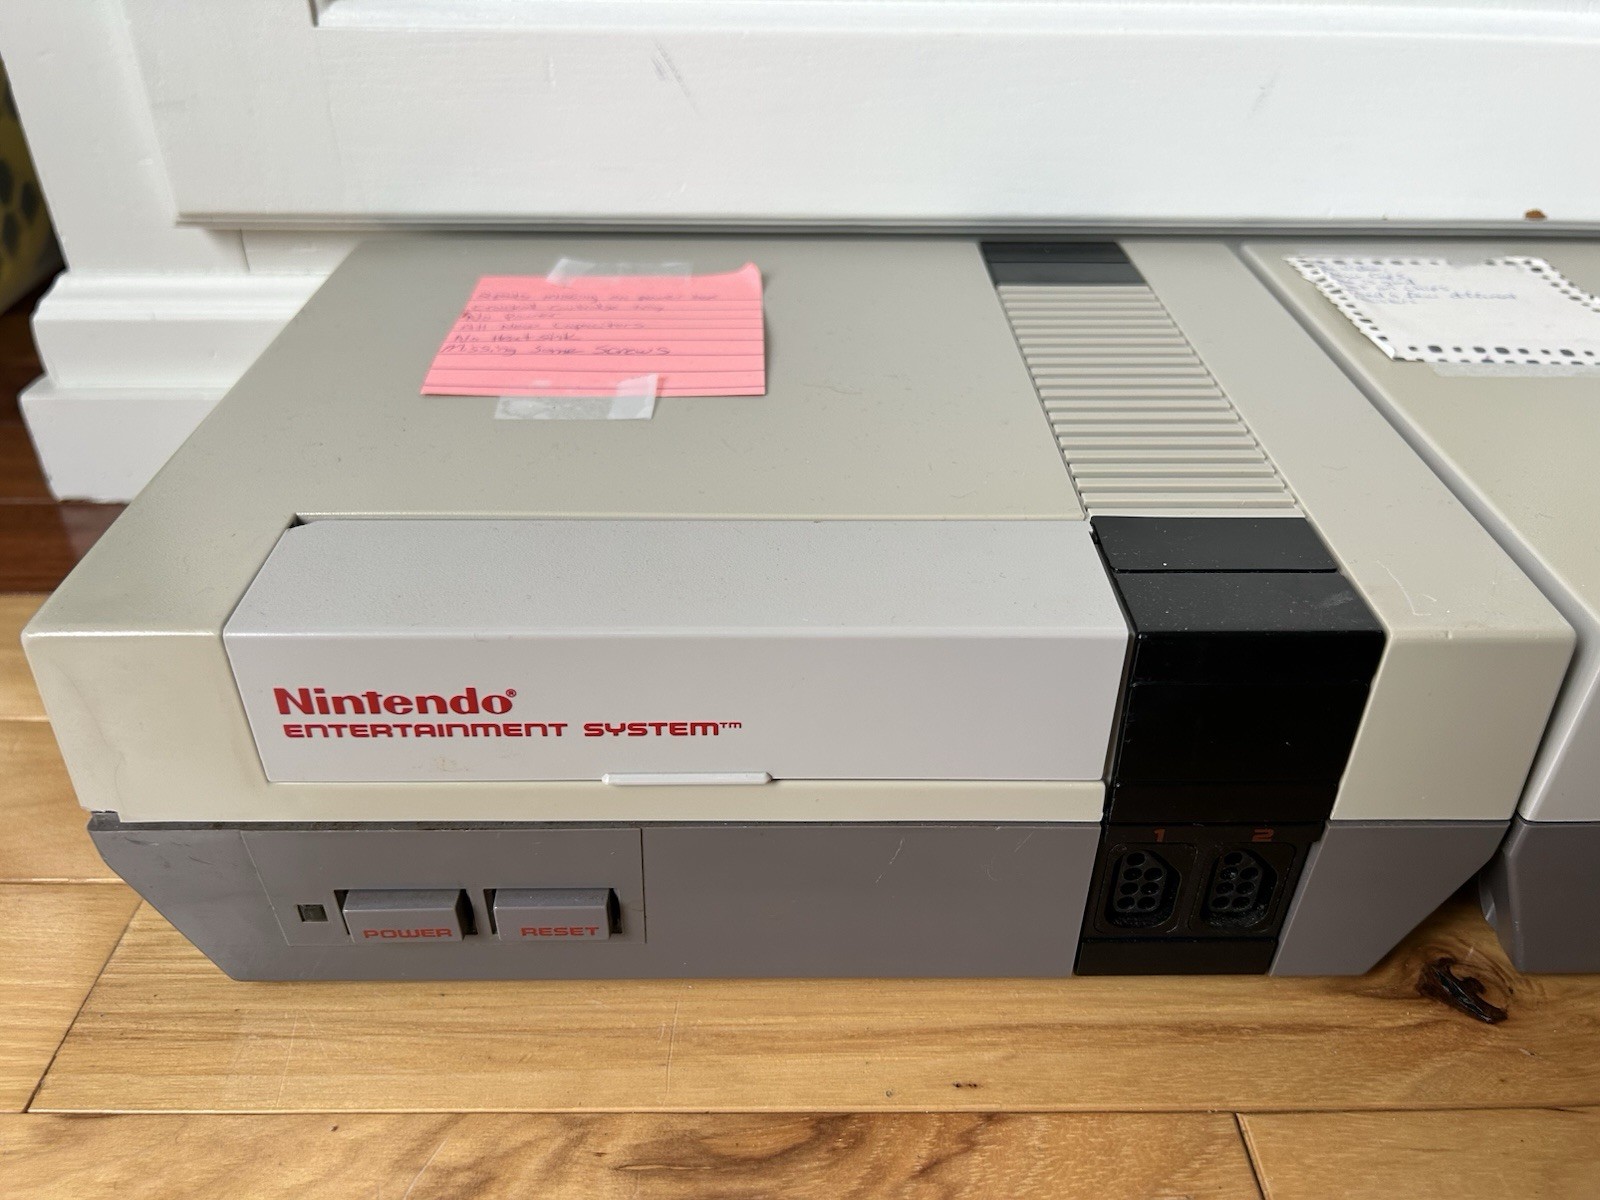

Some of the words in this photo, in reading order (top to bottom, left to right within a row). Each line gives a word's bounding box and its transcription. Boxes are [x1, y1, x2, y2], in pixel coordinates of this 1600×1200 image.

[284, 722, 568, 739] ENTERTAINMENT
[1153, 828, 1166, 843] 1
[1252, 828, 1274, 842] 2
[363, 928, 453, 939] POWER
[521, 926, 600, 937] RESET
